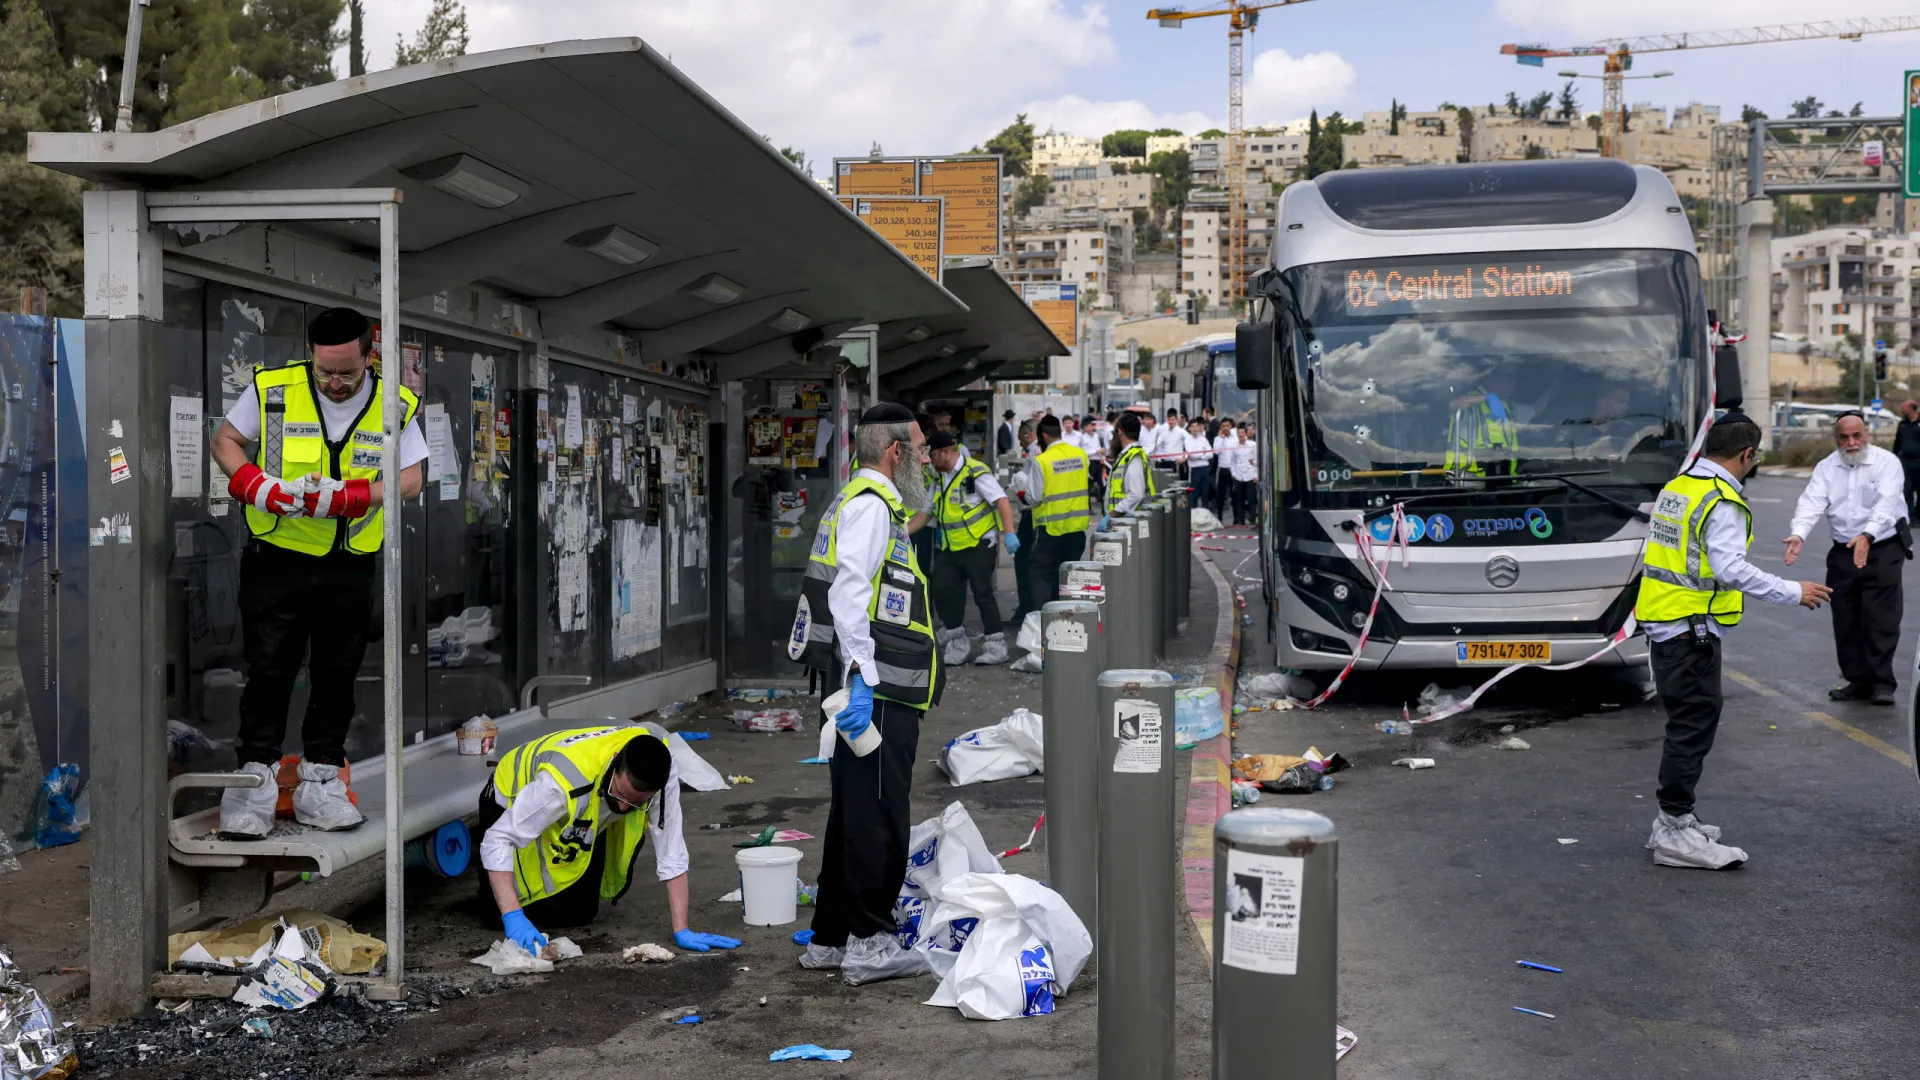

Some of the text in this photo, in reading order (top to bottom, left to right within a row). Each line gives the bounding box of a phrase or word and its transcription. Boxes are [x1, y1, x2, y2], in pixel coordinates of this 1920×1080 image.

[1348, 265, 1572, 307] 62 Central Station
[354, 432, 384, 444] שטרה
[1463, 517, 1525, 532] סופרבוס
[1022, 969, 1054, 979] הצלה
